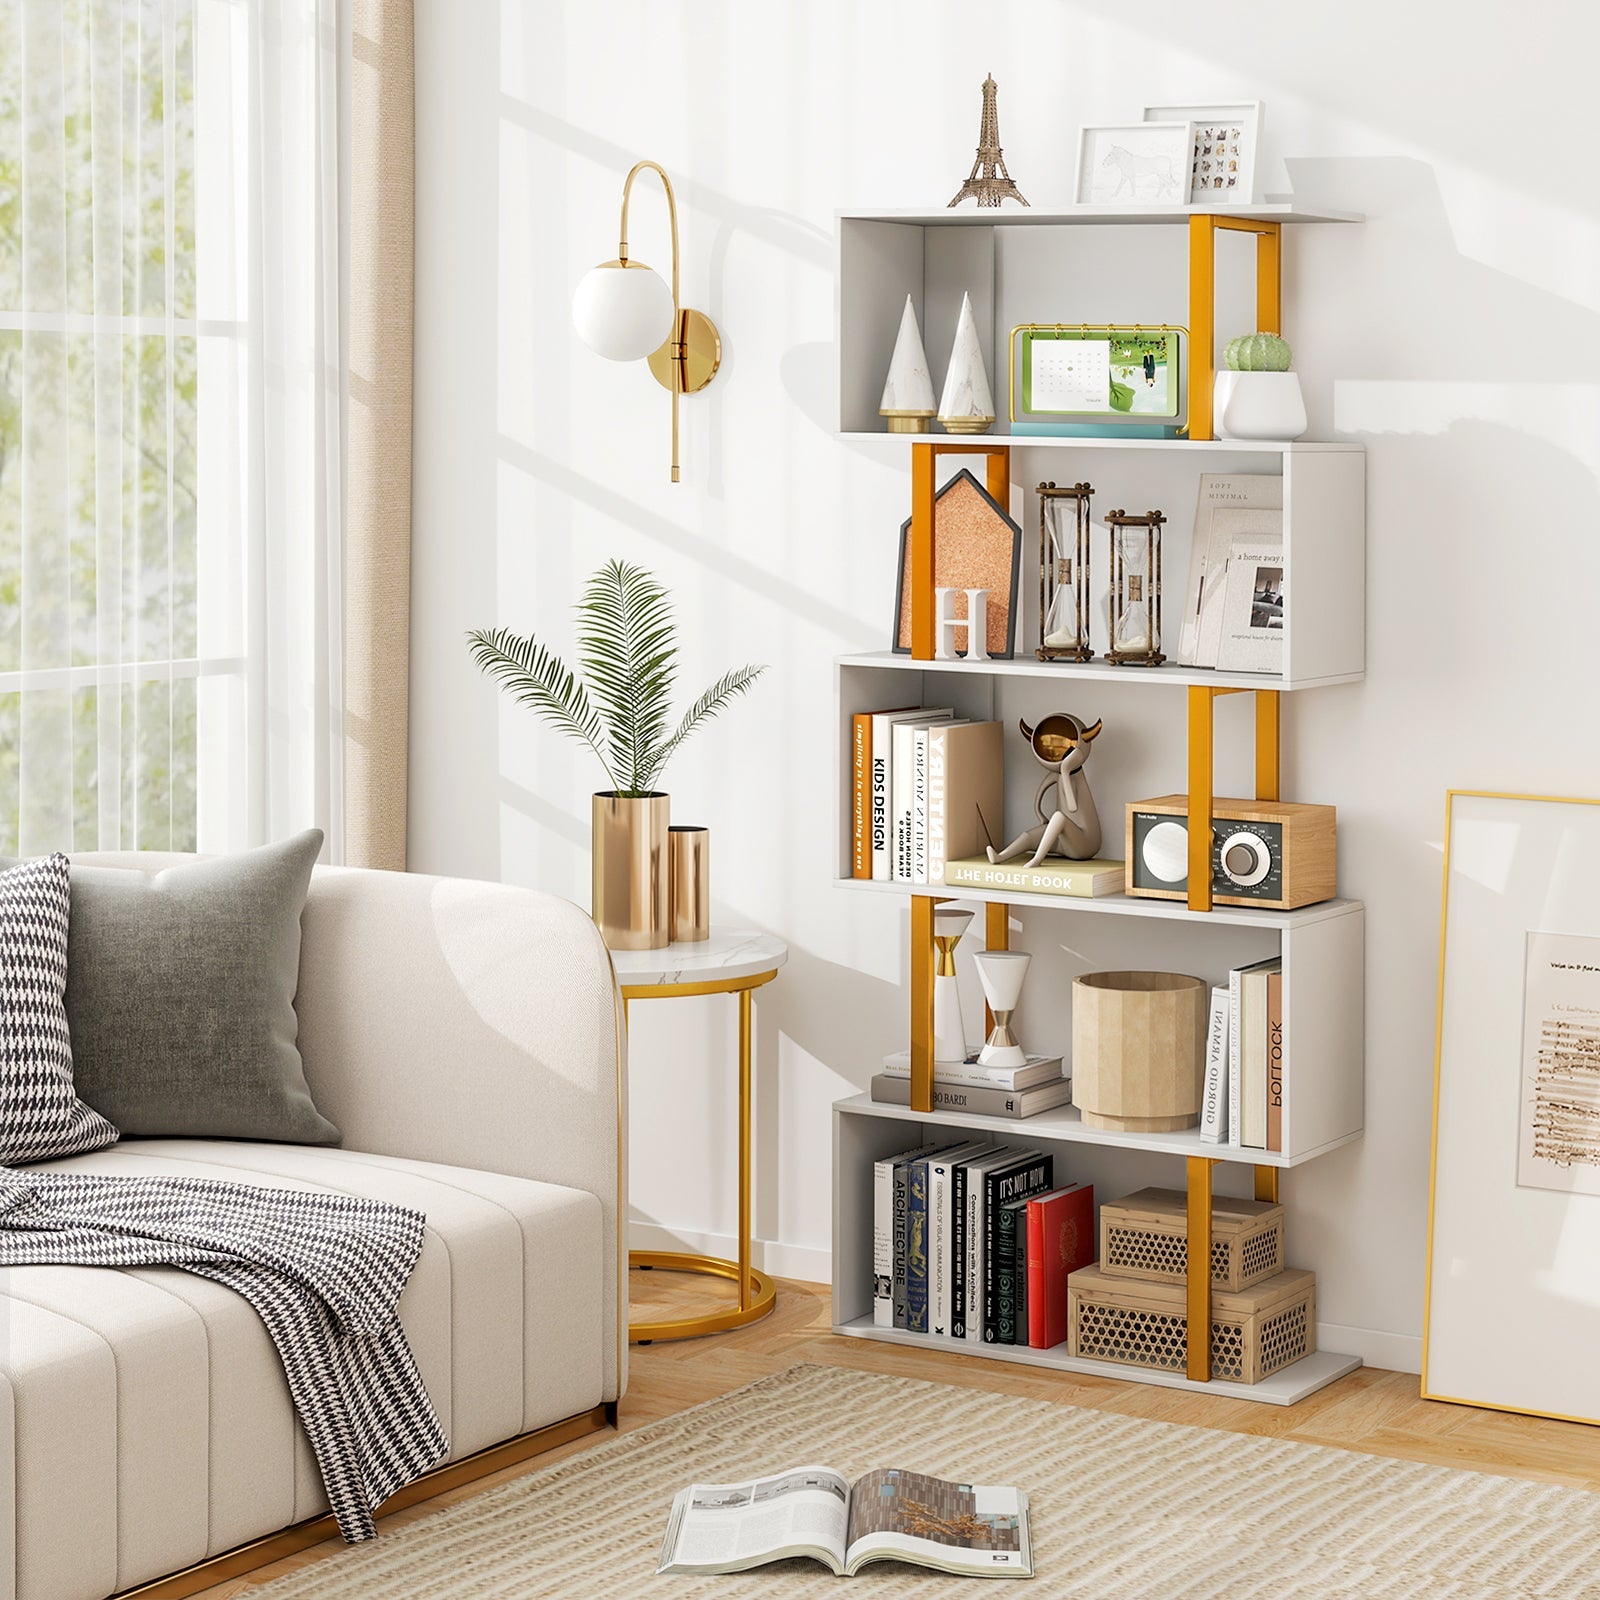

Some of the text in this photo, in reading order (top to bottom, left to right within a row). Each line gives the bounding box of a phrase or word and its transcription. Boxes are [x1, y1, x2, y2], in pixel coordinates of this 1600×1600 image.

[1243, 553, 1262, 561] home
[1264, 555, 1280, 563] away
[856, 724, 864, 768] simplicity
[856, 770, 864, 779] is
[856, 781, 863, 789] in
[874, 758, 885, 851] KIDS DESIGN
[856, 792, 864, 839] everything
[856, 840, 863, 852] we
[944, 1093, 967, 1106] BARDI
[1000, 1166, 1045, 1199] IT'S NOT HOW
[936, 1215, 943, 1223] OF
[896, 1180, 905, 1286] ARCHITECTURE
